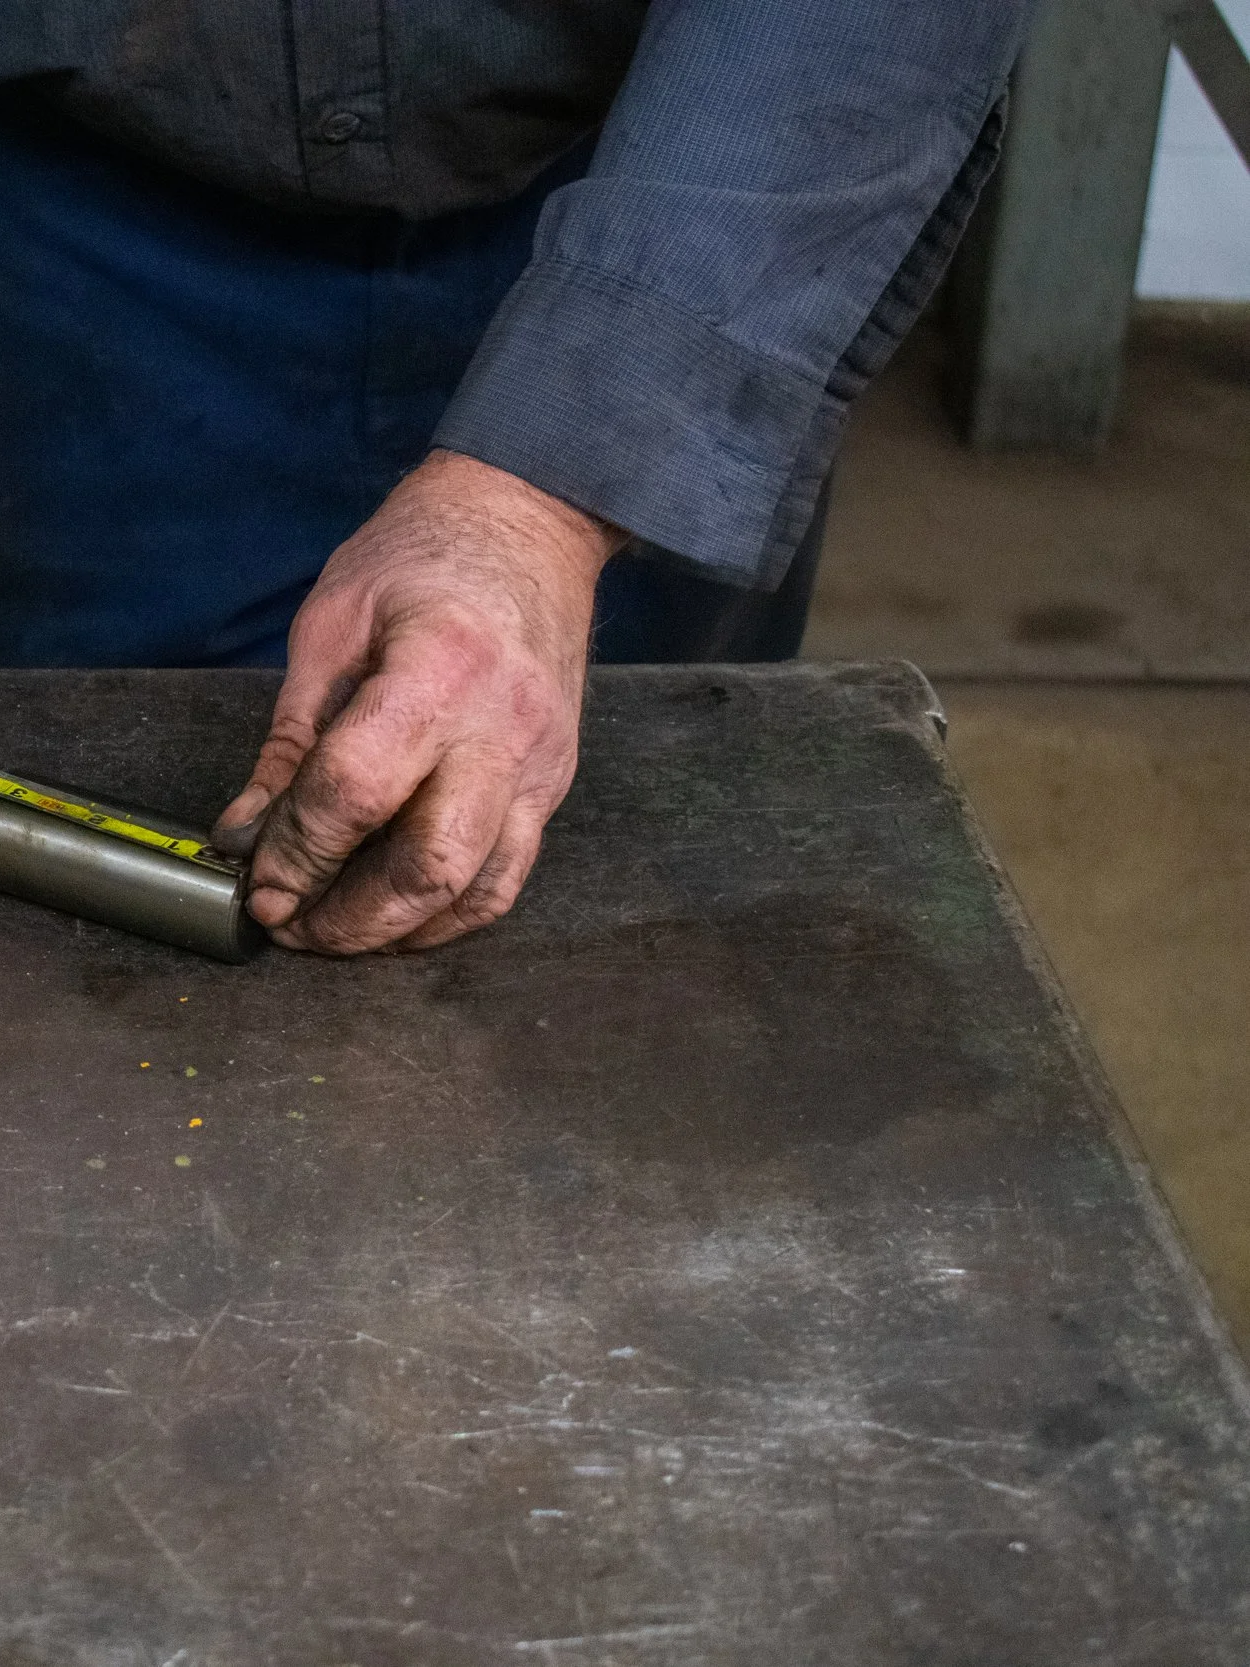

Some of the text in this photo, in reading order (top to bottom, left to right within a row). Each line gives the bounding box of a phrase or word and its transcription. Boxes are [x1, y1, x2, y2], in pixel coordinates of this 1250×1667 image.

[9, 788, 29, 798] 3
[88, 813, 107, 825] 2
[167, 840, 180, 852] 1
